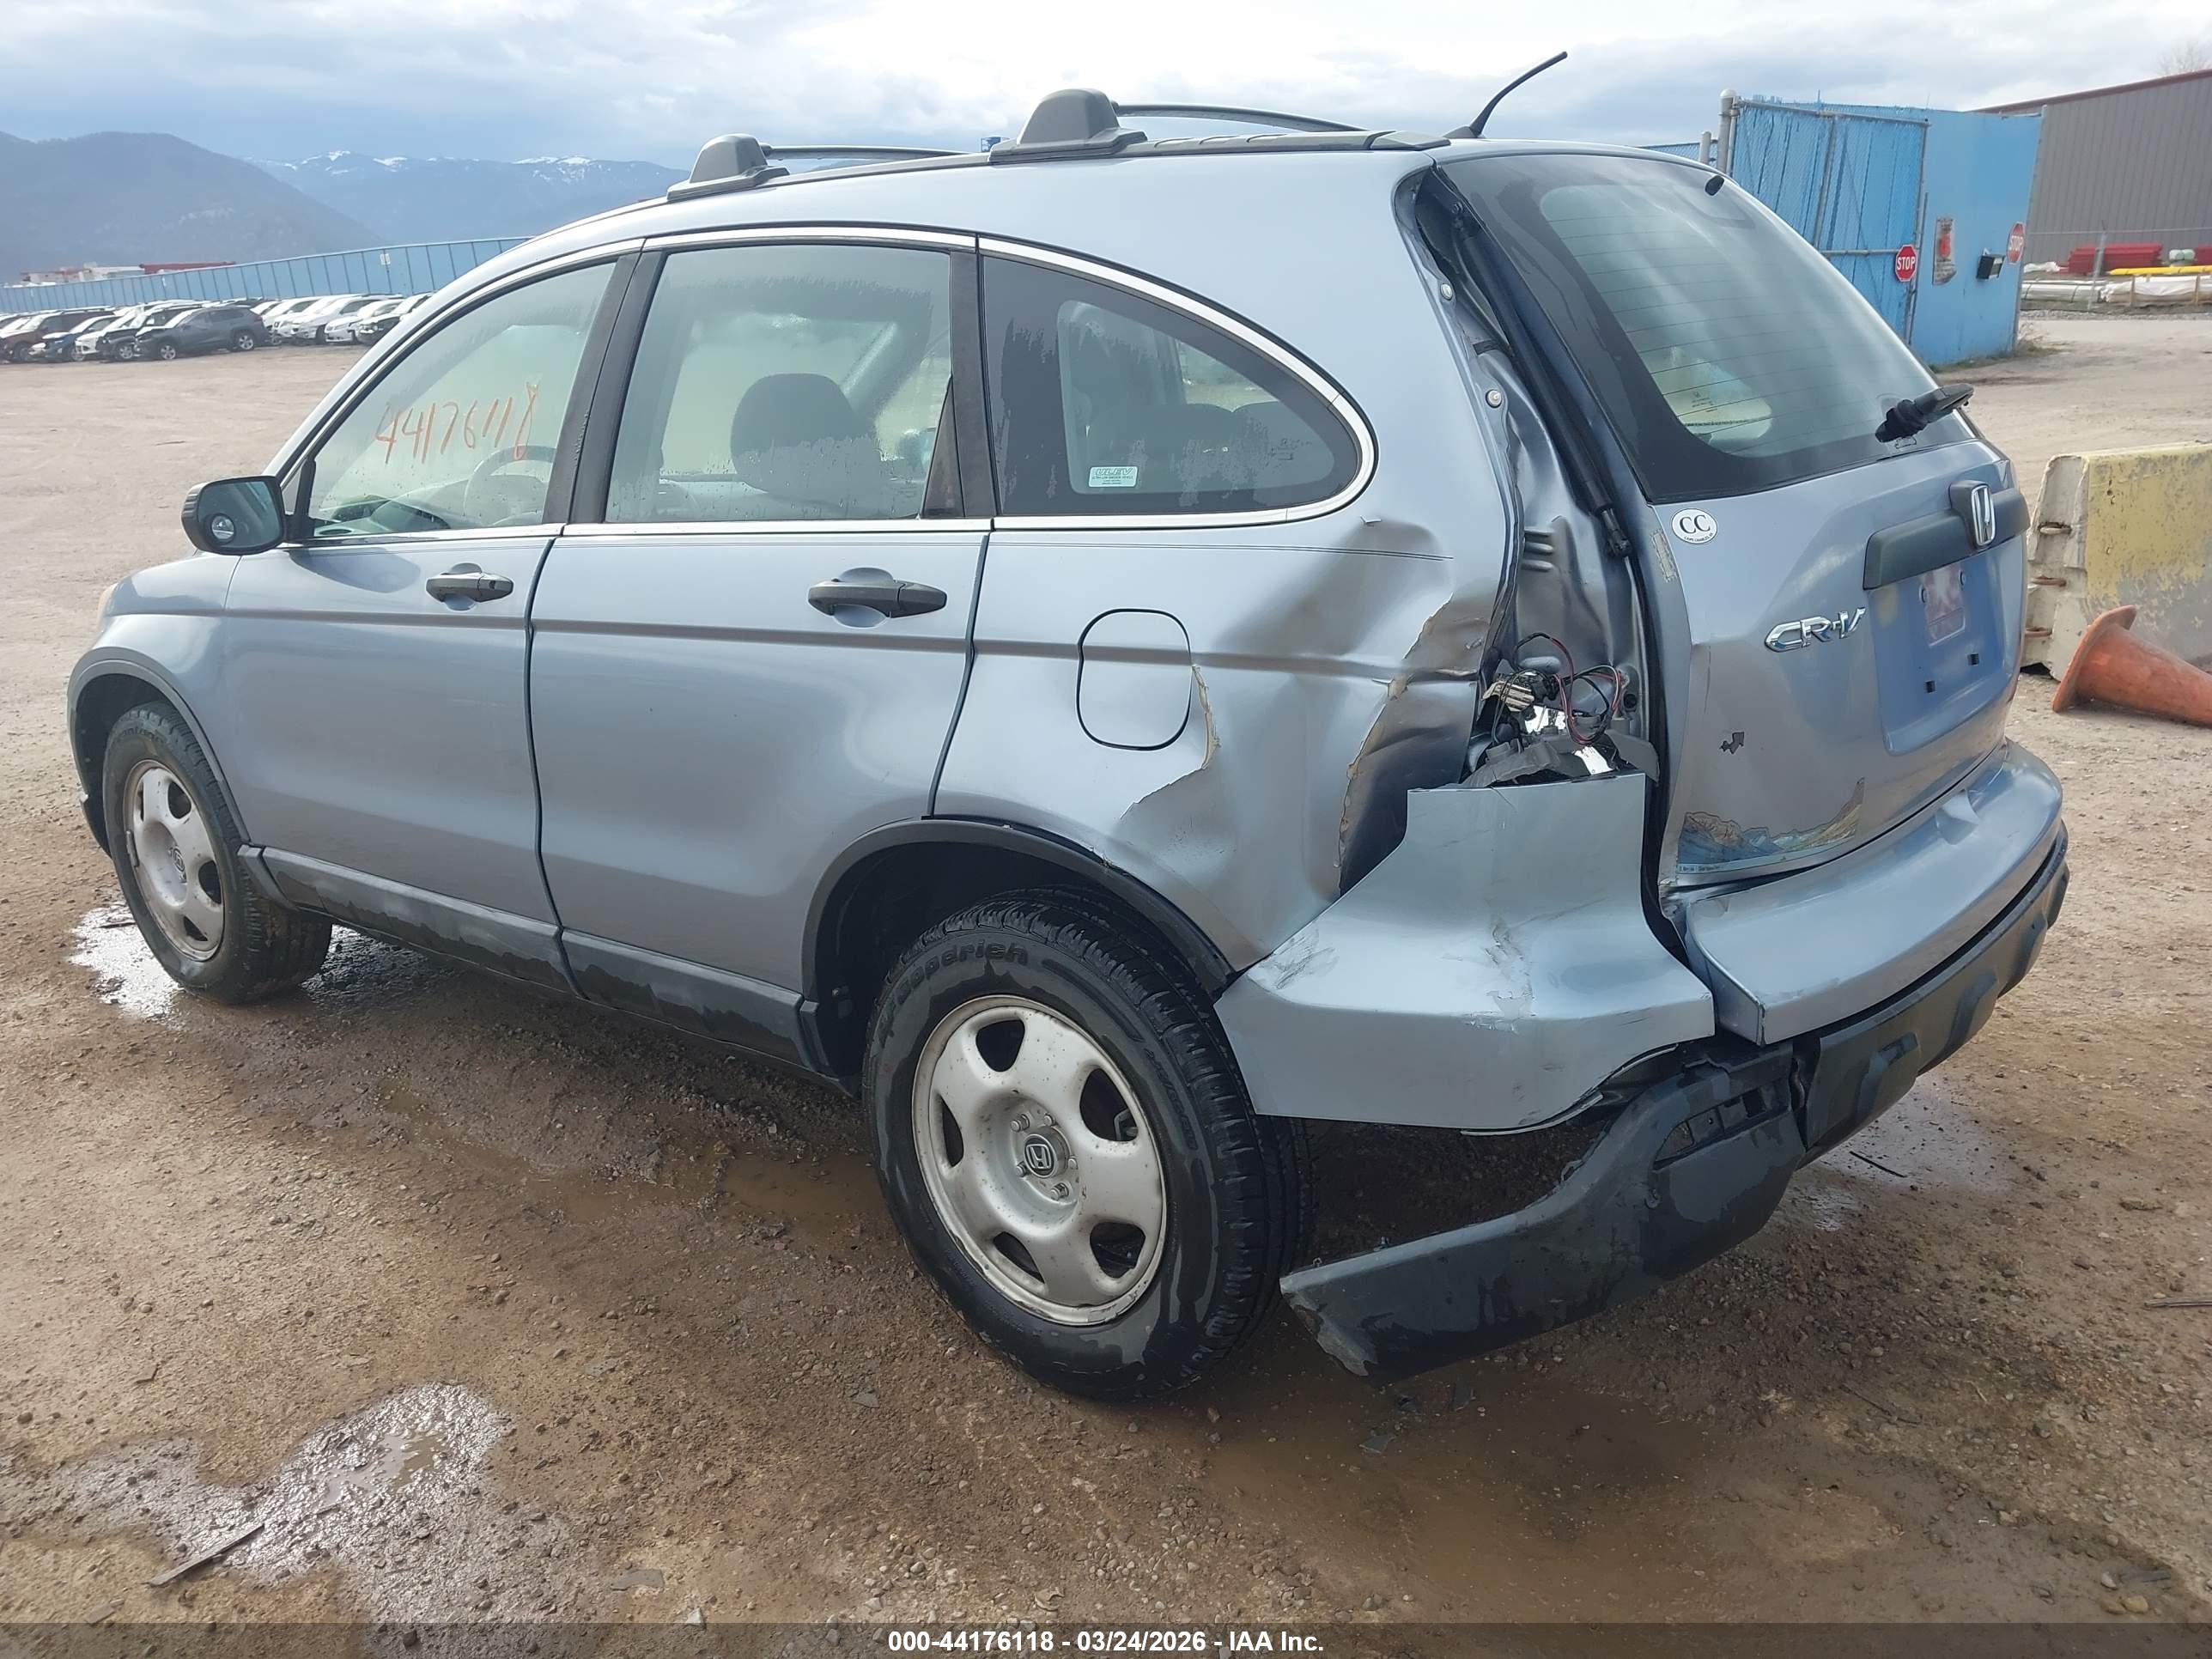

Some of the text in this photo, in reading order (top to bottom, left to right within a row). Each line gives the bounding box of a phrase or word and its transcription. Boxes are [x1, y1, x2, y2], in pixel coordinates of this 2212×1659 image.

[2008, 235, 2025, 251] STOP
[1897, 257, 1916, 270] STOP
[375, 381, 538, 465] 44176118
[1680, 515, 1711, 534] CC
[1765, 607, 1866, 653] CR-V
